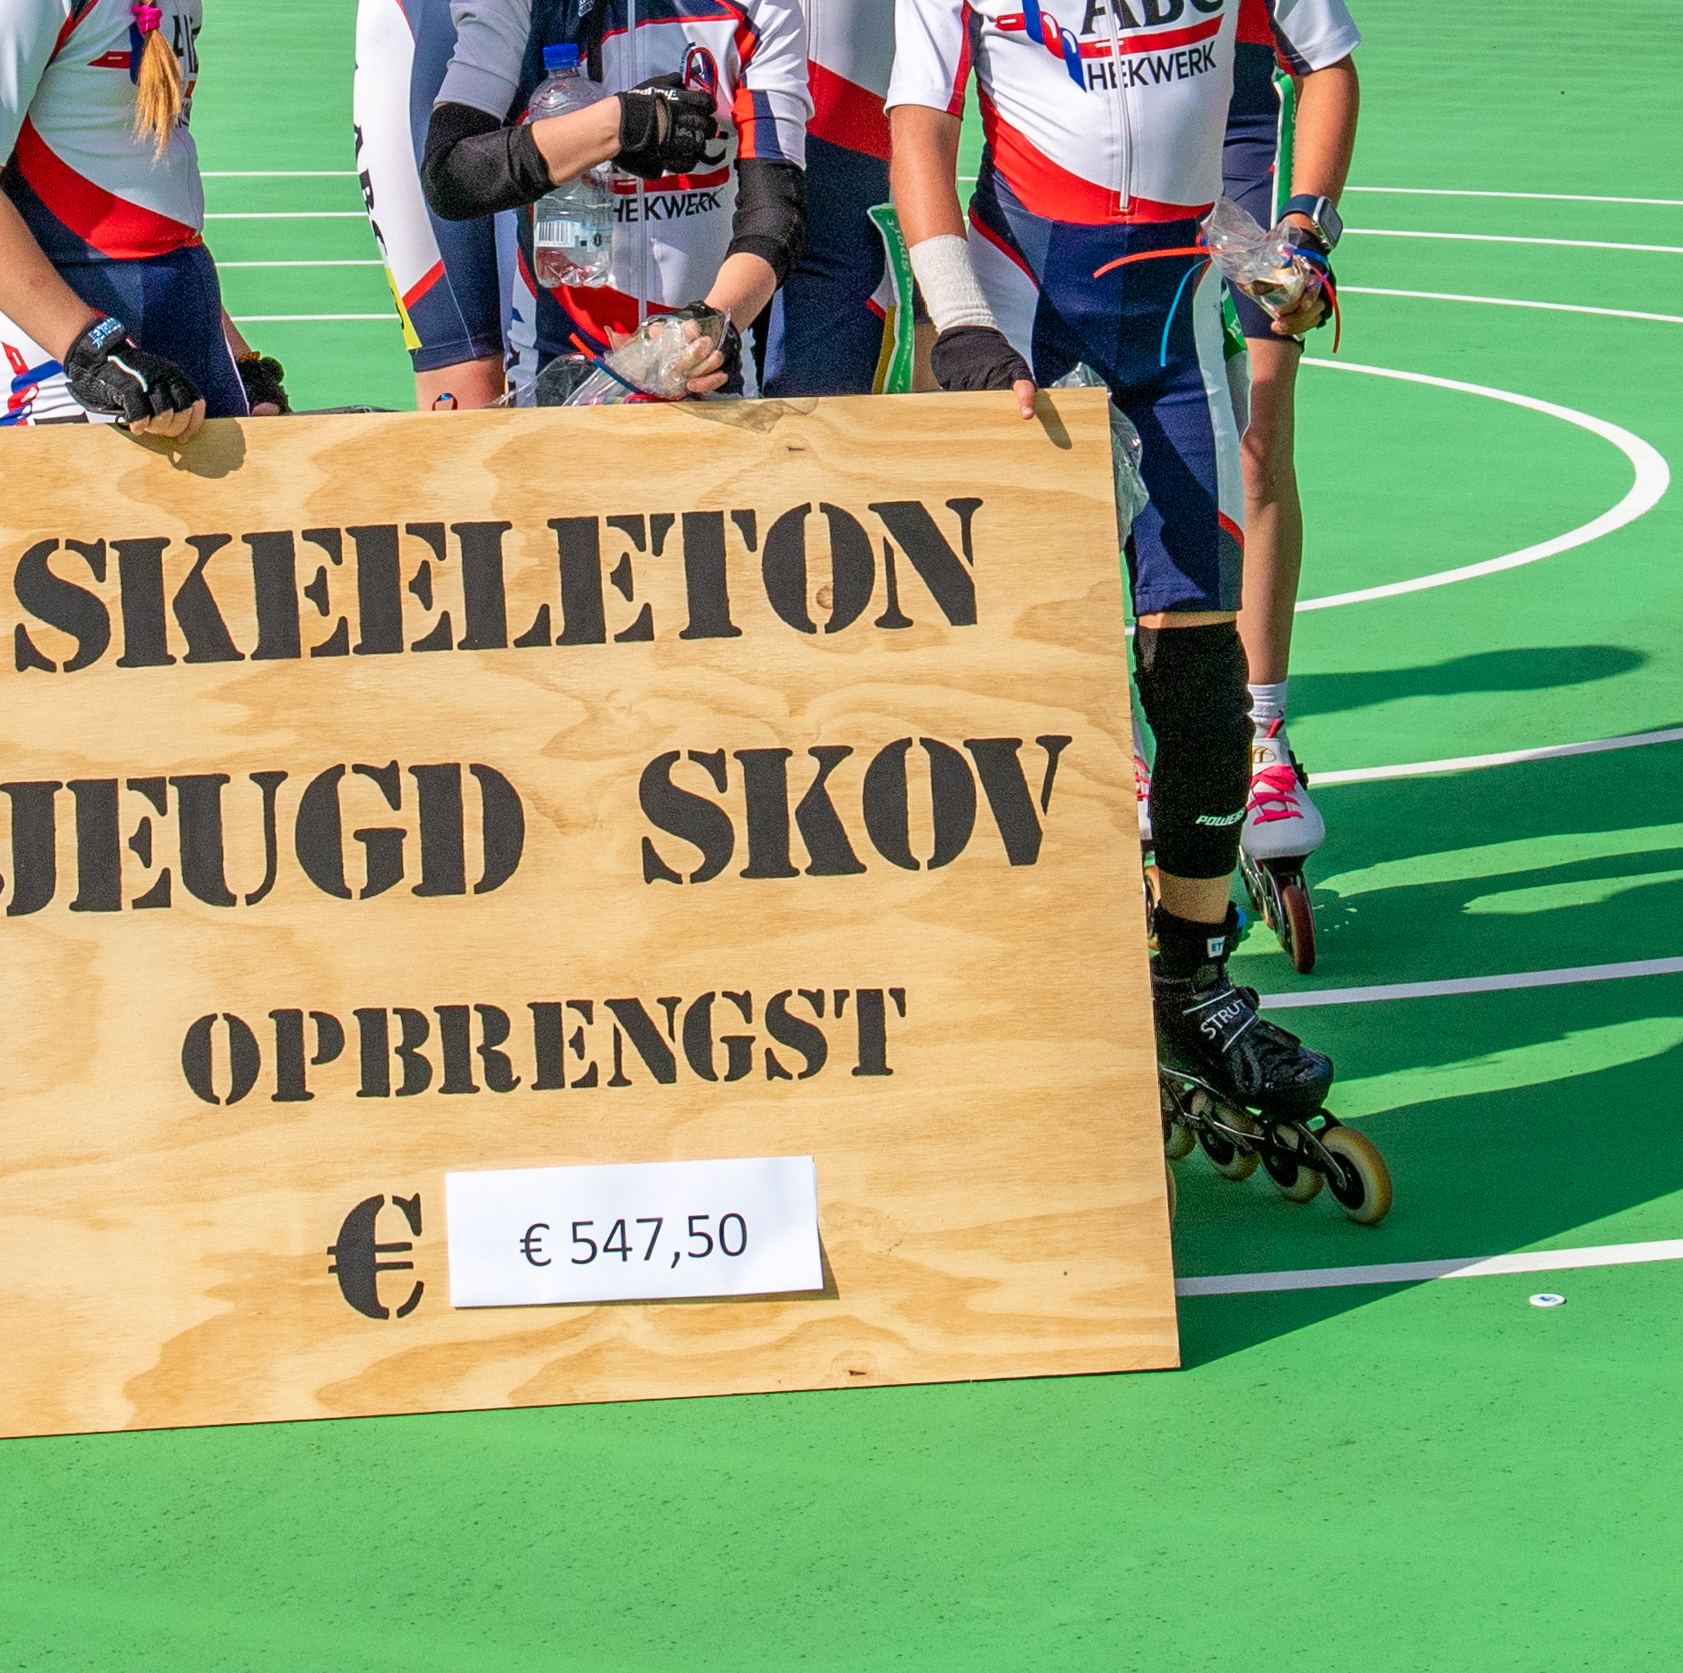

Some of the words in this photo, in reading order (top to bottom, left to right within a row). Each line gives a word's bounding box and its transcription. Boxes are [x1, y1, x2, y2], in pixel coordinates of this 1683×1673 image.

[1086, 40, 1217, 93] HEKWERK
[14, 498, 982, 672] SKEELETON
[639, 736, 1072, 884] SKOV
[182, 988, 905, 1105] OPBRENGST
[328, 1195, 423, 1319] €
[521, 1223, 551, 1266] €
[572, 1213, 747, 1268] 547,50
